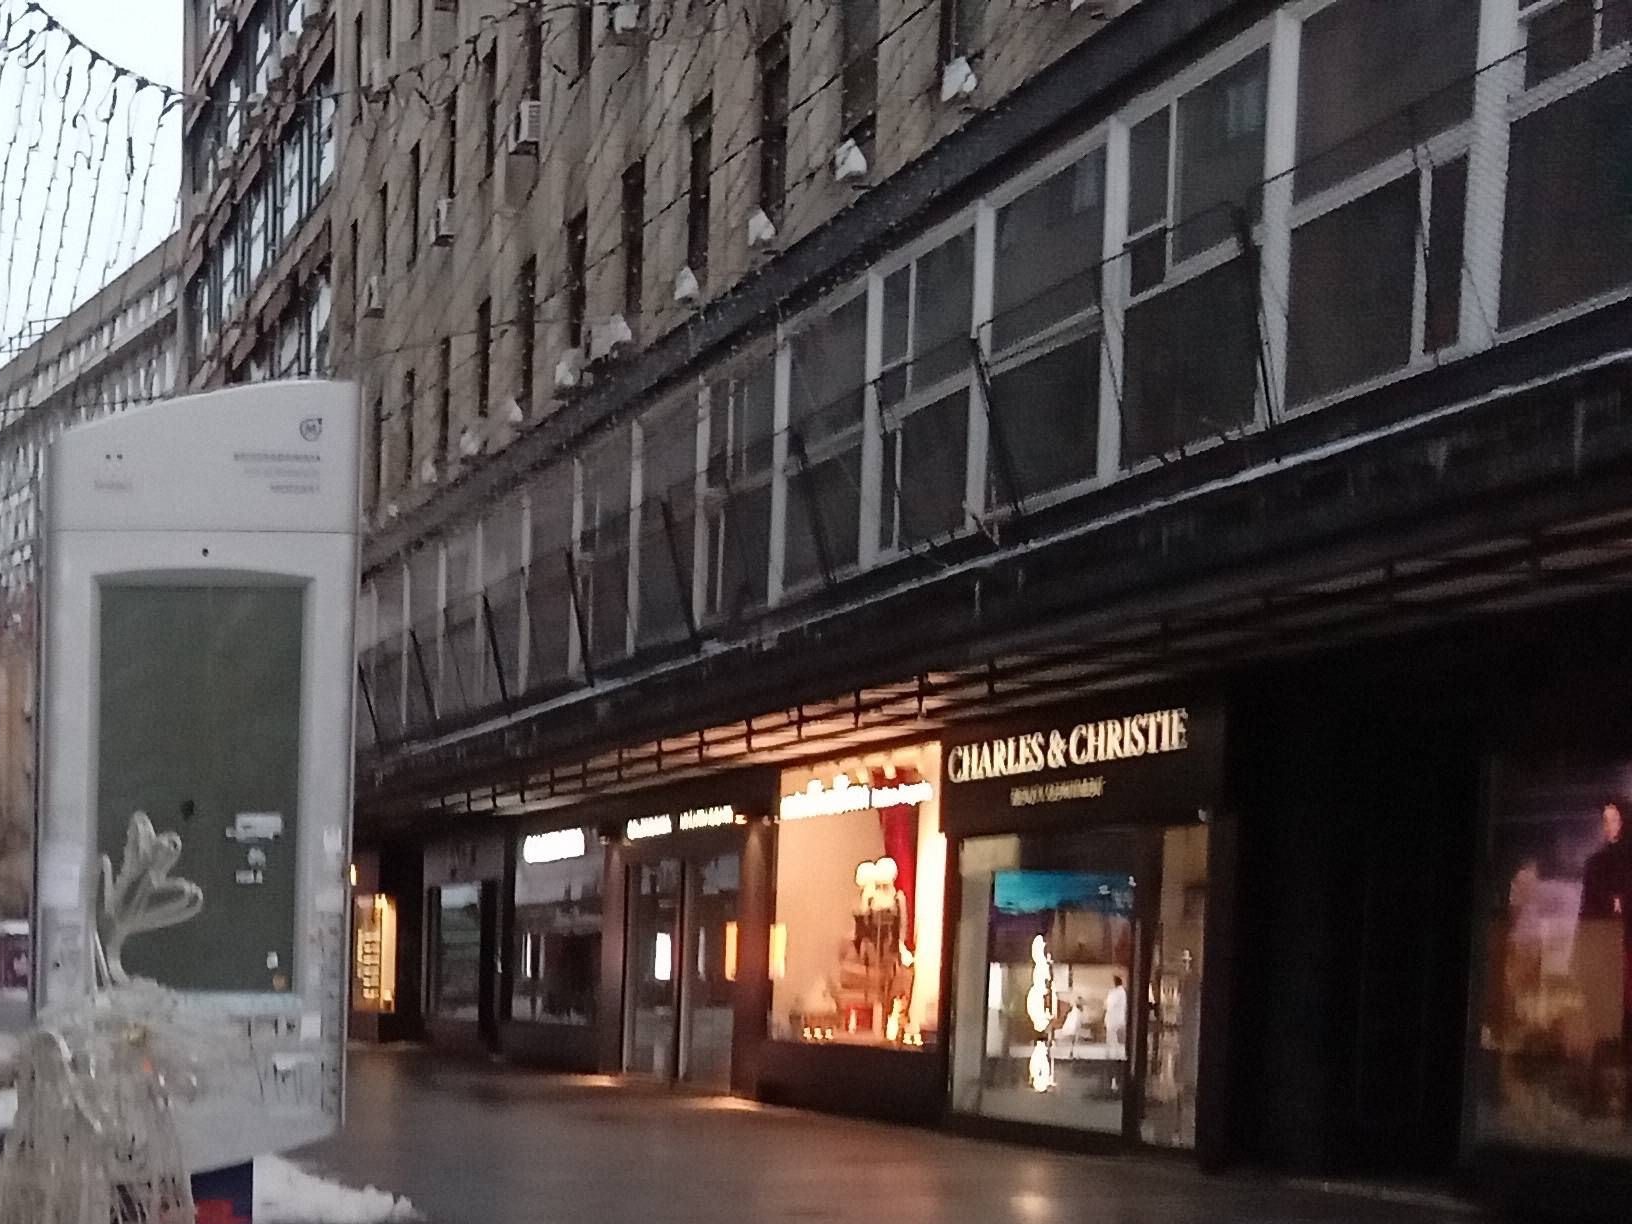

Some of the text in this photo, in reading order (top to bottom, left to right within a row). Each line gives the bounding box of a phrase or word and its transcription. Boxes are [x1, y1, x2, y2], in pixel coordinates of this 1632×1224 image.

[948, 708, 1188, 783] CHARLES & CHRISTIE
